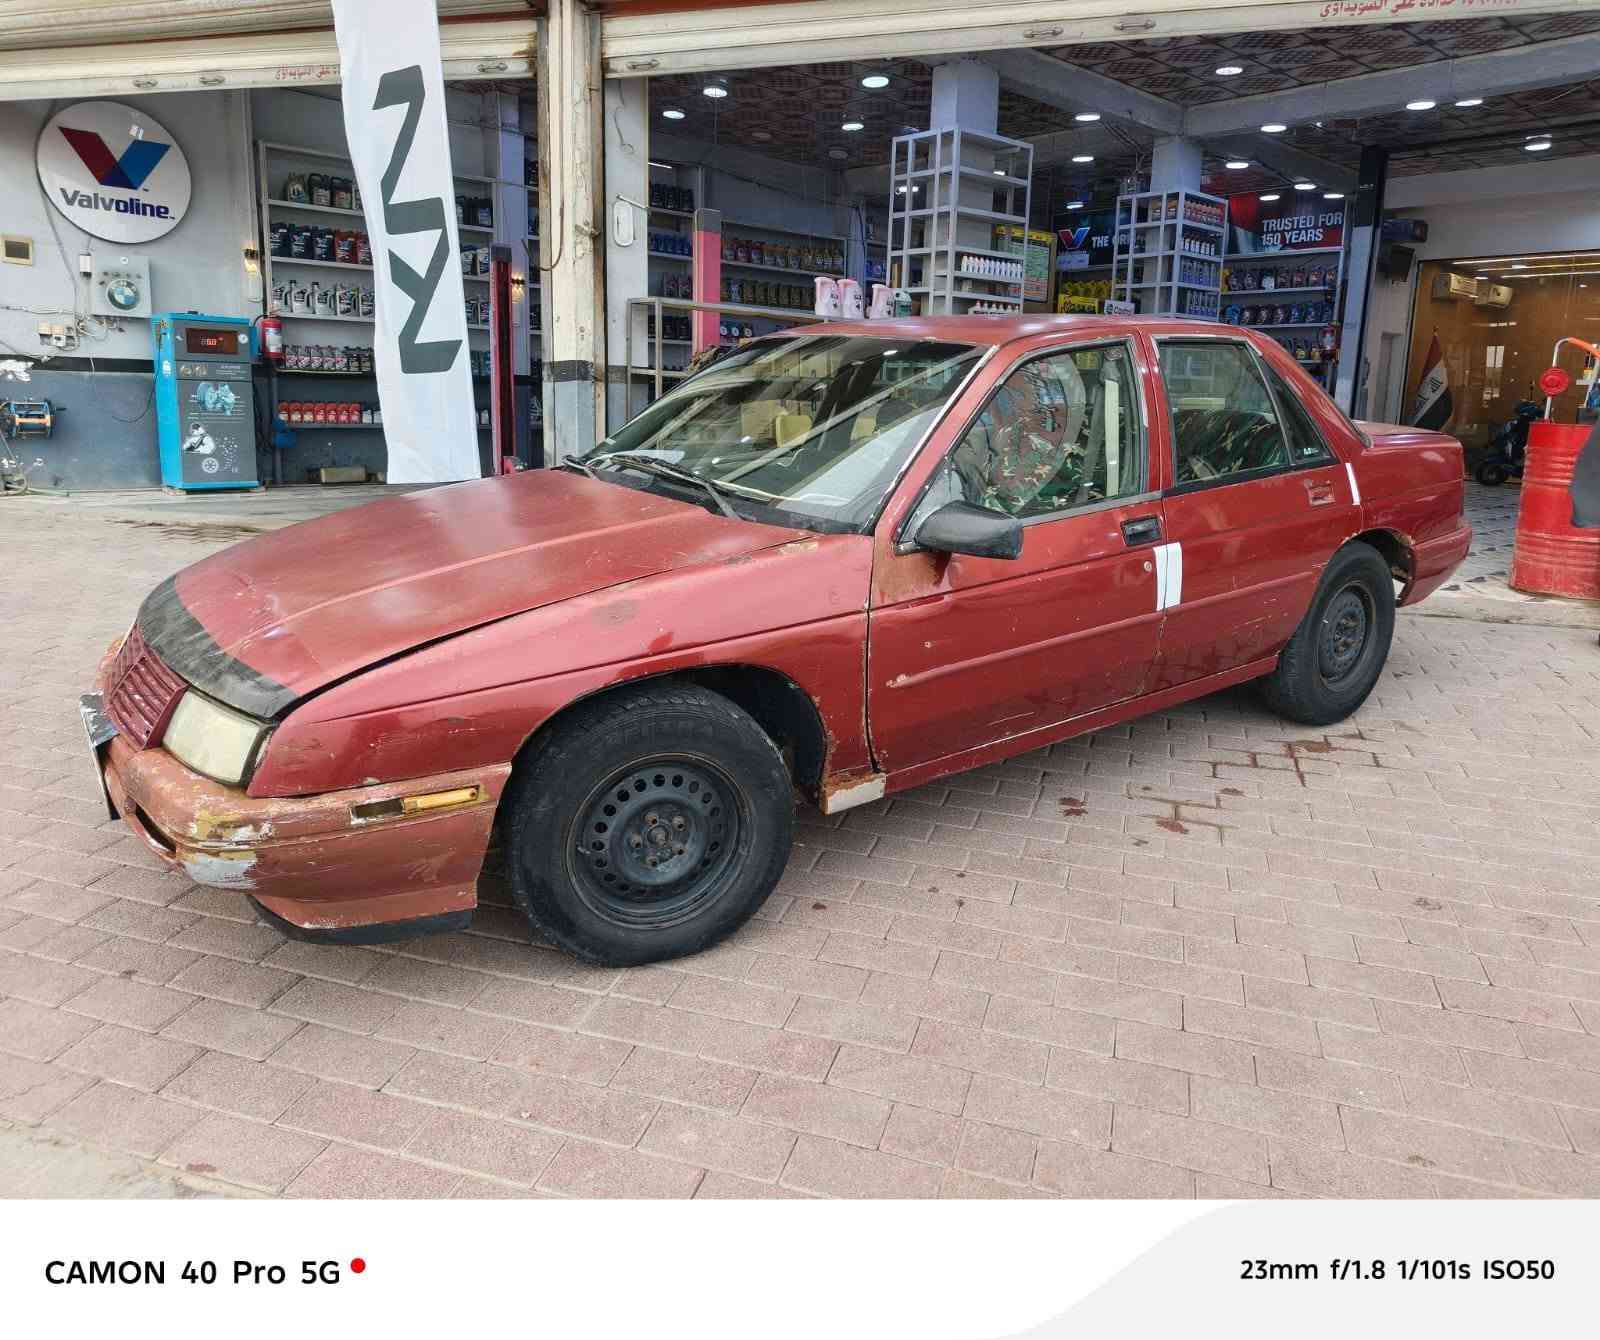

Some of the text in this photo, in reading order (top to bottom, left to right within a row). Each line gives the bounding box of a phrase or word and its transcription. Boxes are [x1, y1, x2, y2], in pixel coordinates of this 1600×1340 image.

[60, 187, 170, 219] Valvoline
[1262, 212, 1343, 233] TRUSTED FOR
[1091, 235, 1109, 248] THE
[1262, 228, 1324, 246] 150 YEARS
